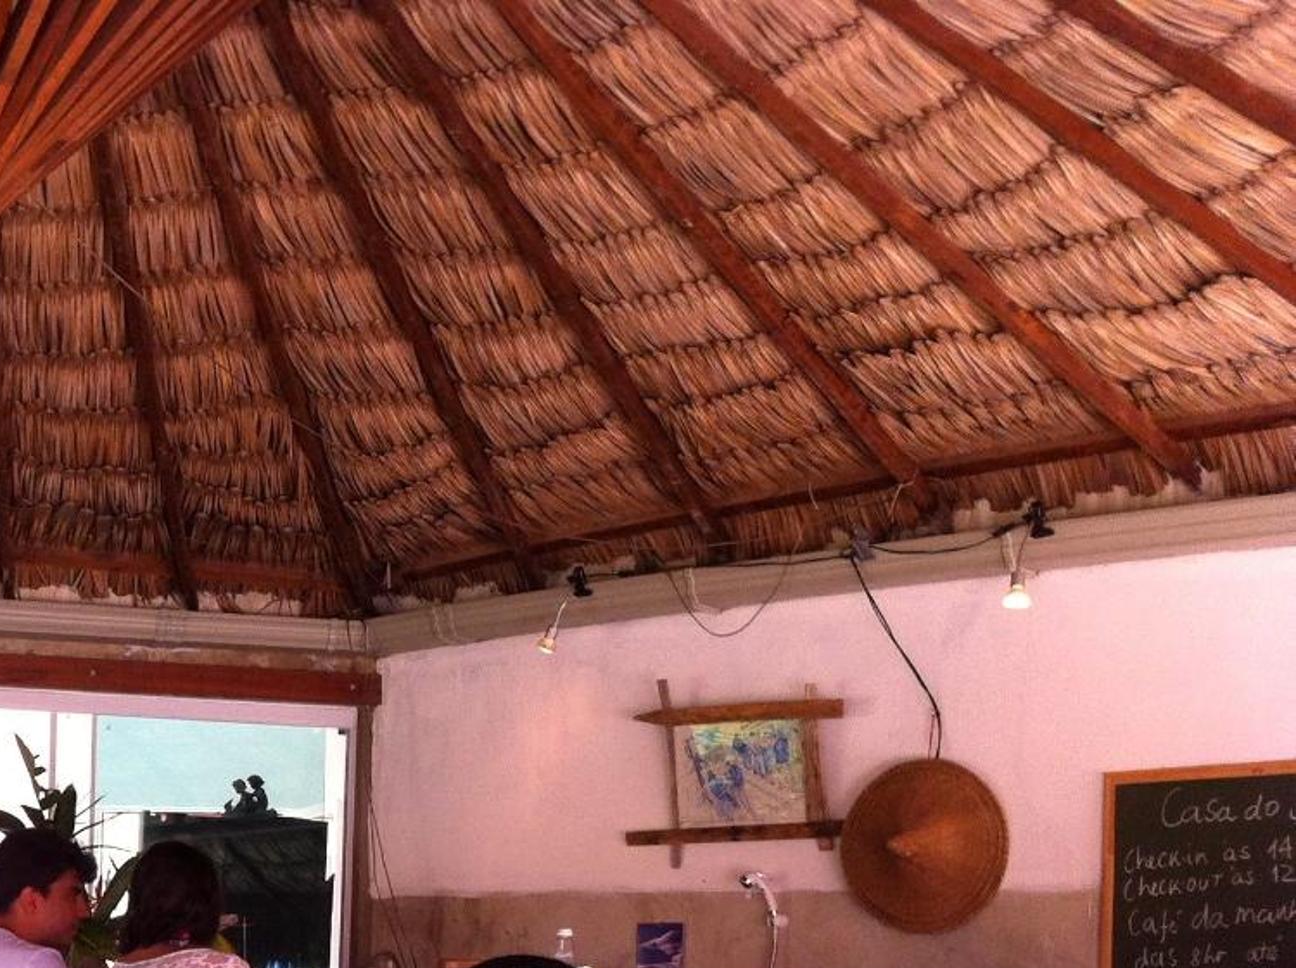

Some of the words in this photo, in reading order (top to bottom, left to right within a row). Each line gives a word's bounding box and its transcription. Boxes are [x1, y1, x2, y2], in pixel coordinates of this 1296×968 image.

[1162, 787, 1236, 828] Casa
[1244, 794, 1280, 821] do
[1272, 863, 1296, 884] 12
[1128, 908, 1182, 943] Café
[1191, 903, 1229, 930] da
